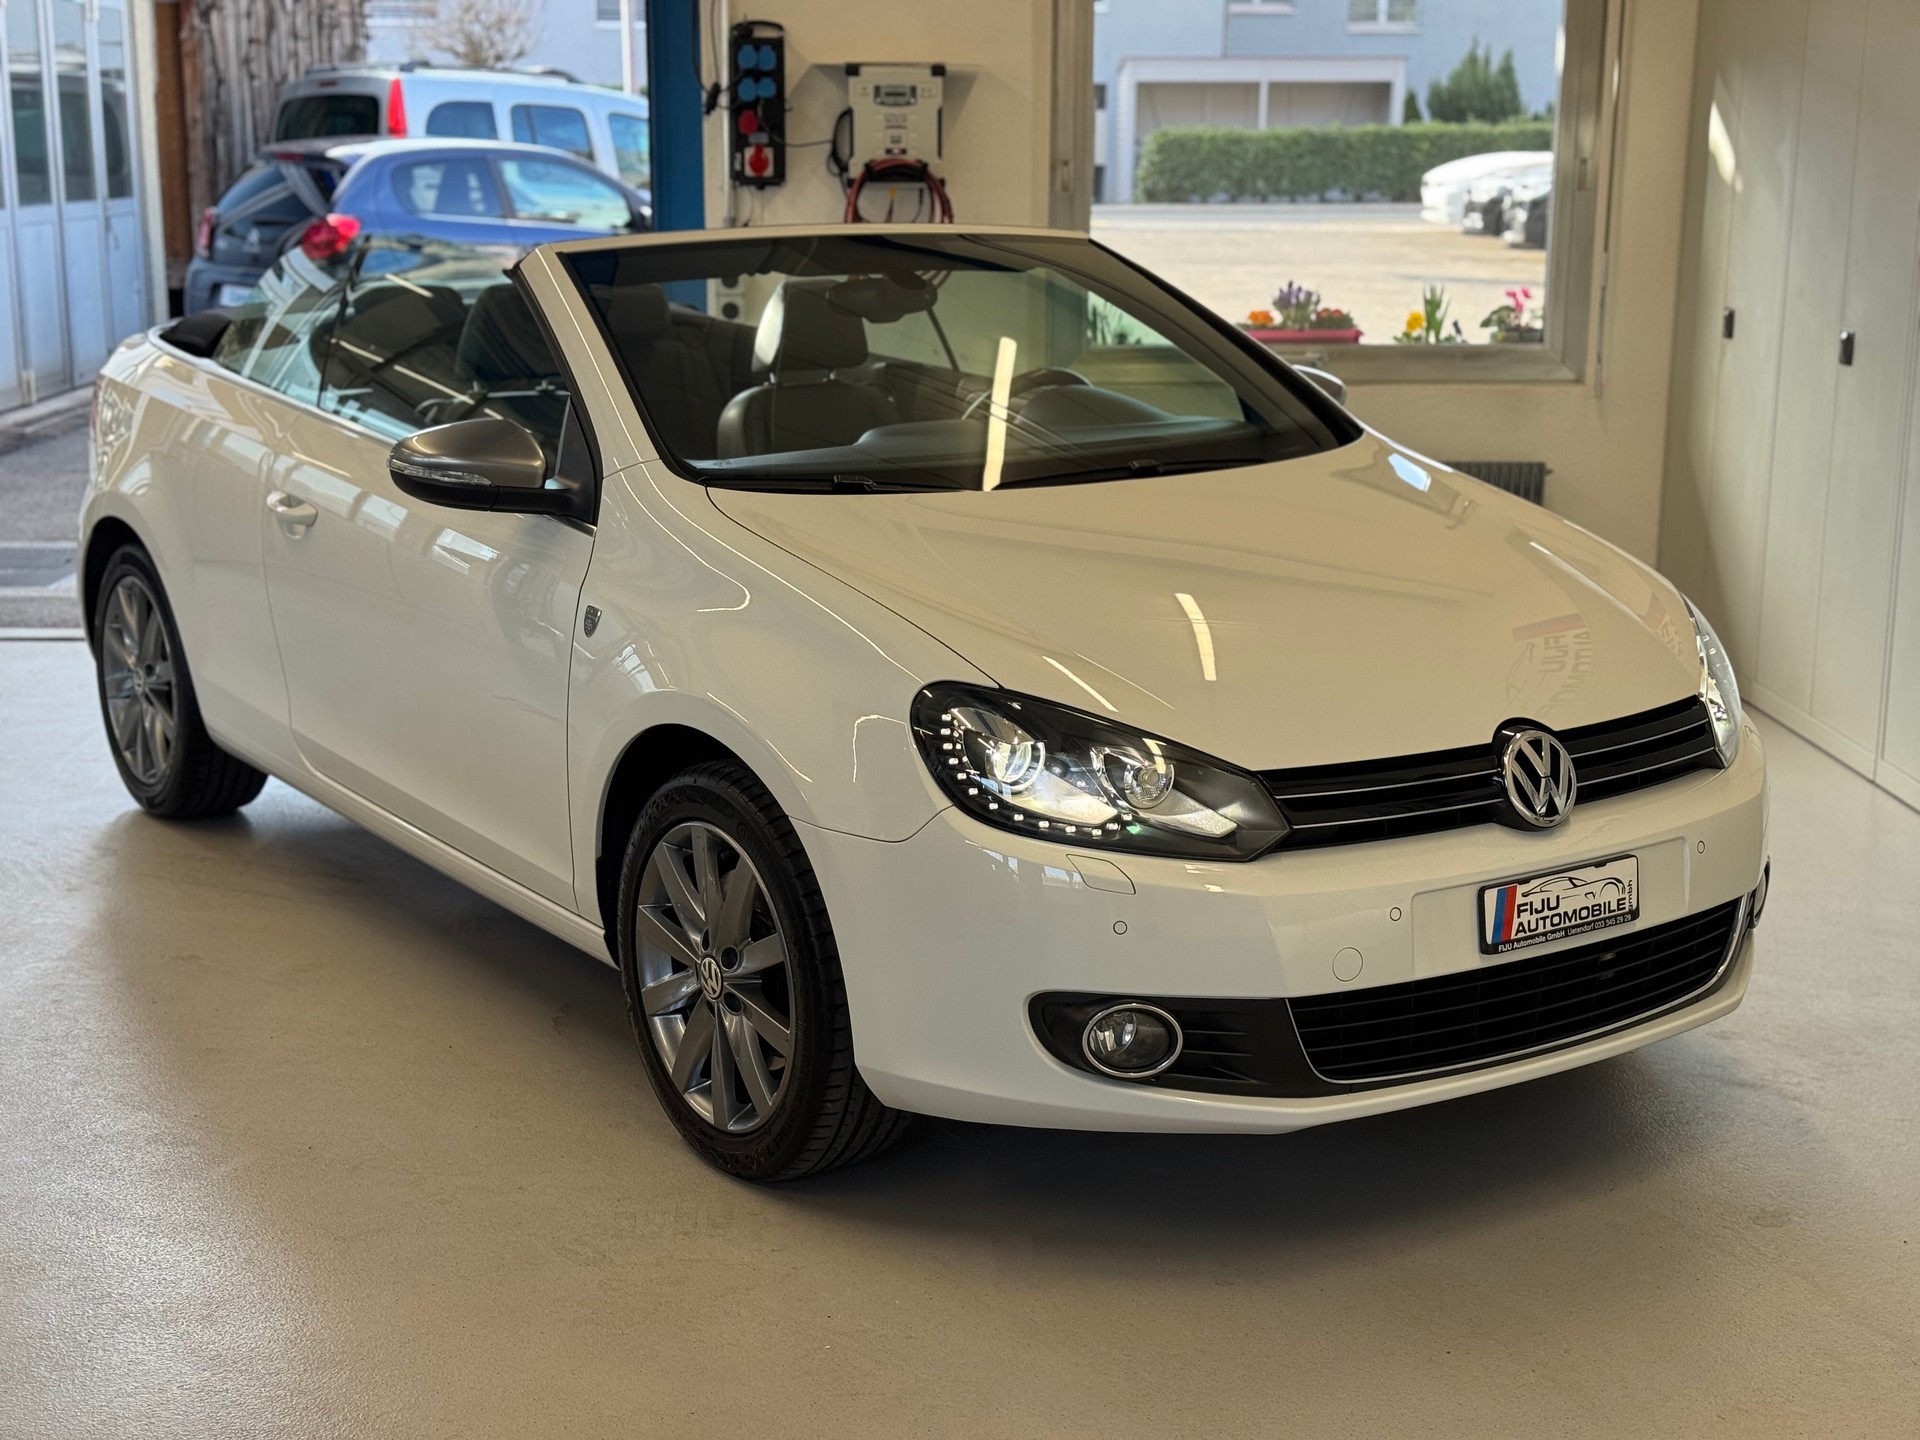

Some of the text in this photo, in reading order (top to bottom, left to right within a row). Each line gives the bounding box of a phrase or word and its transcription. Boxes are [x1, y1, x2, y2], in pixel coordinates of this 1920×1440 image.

[1514, 897, 1627, 937] AUTOMOBILE
[1516, 895, 1560, 919] FIJU
[1498, 943, 1513, 953] FIJU
[1513, 936, 1546, 949] Automobile
[1547, 930, 1565, 941] GmbH
[1594, 920, 1605, 930] 033
[1616, 915, 1624, 923] 29
